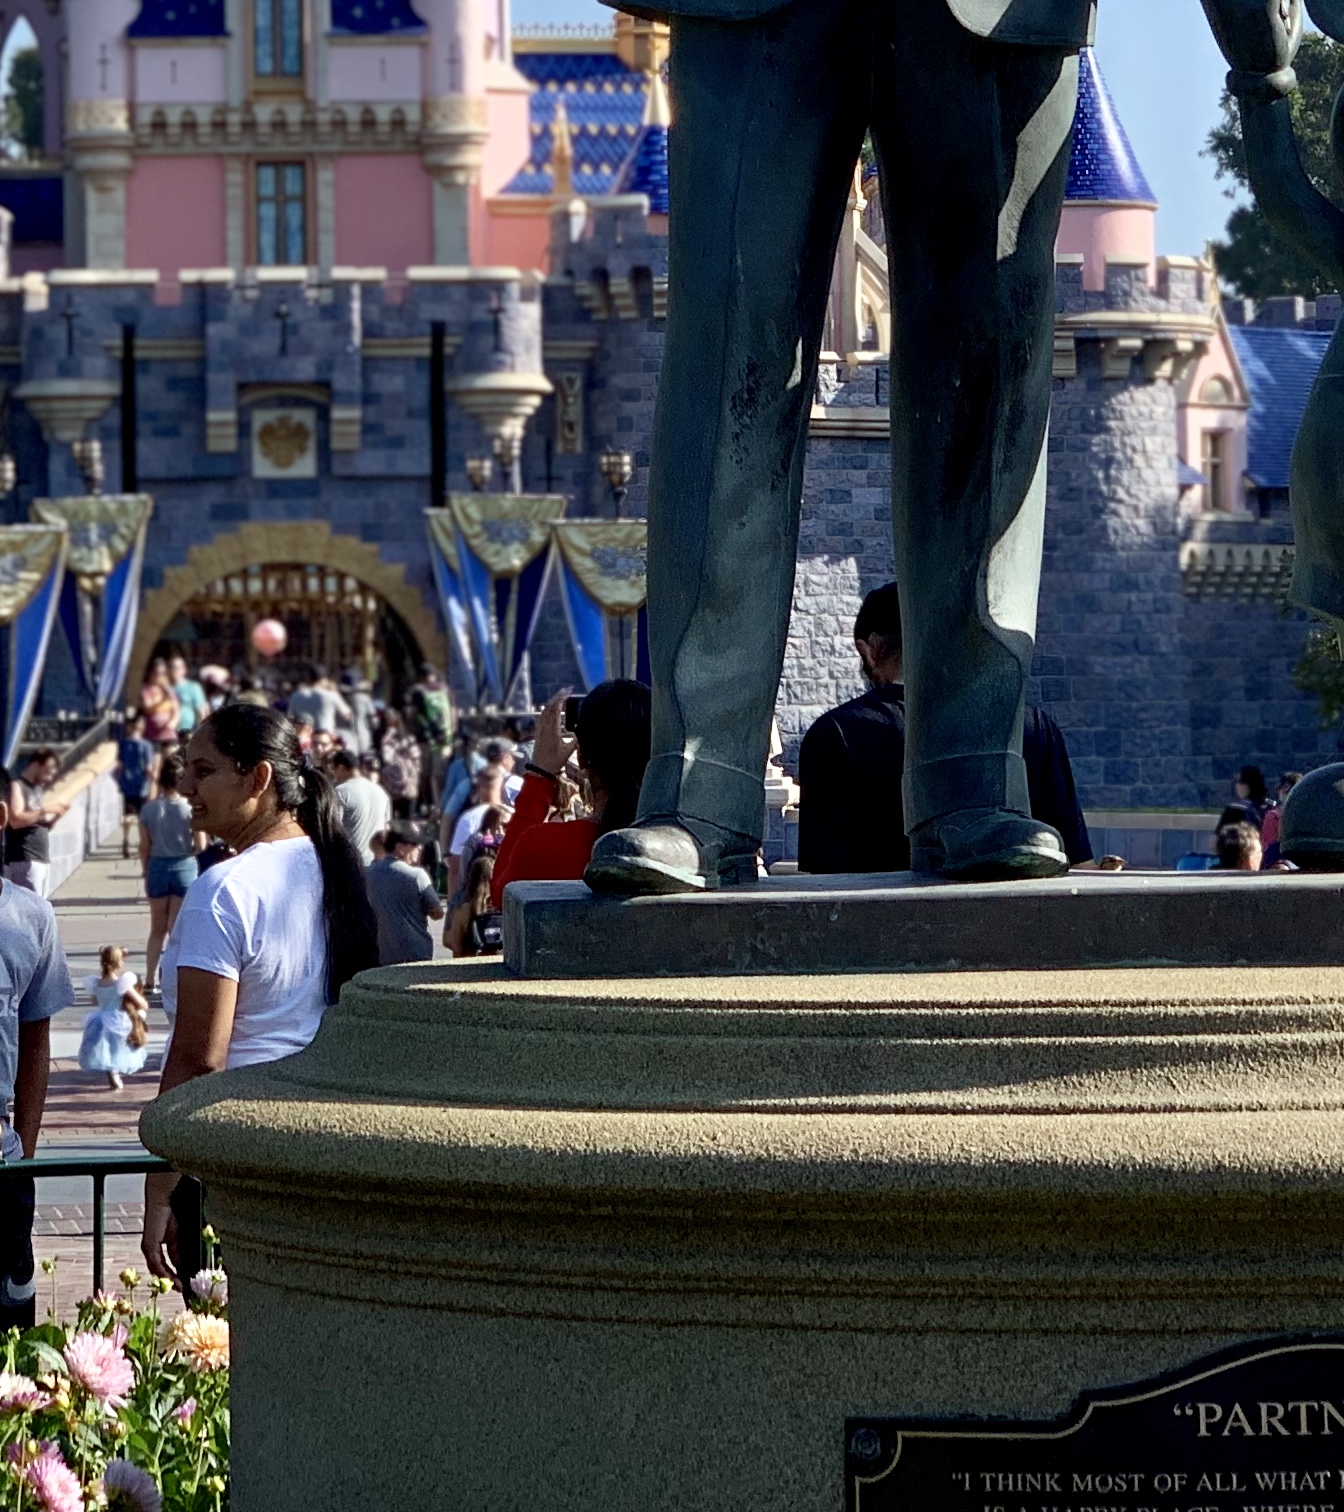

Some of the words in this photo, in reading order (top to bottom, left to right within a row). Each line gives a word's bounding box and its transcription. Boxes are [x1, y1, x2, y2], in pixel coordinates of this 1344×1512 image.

[979, 1472, 1062, 1493] THINK
[1071, 1472, 1145, 1493] MOST
[1153, 1472, 1188, 1494] OF
[1196, 1472, 1247, 1492] ALL
[1255, 1469, 1331, 1491] WHAT
